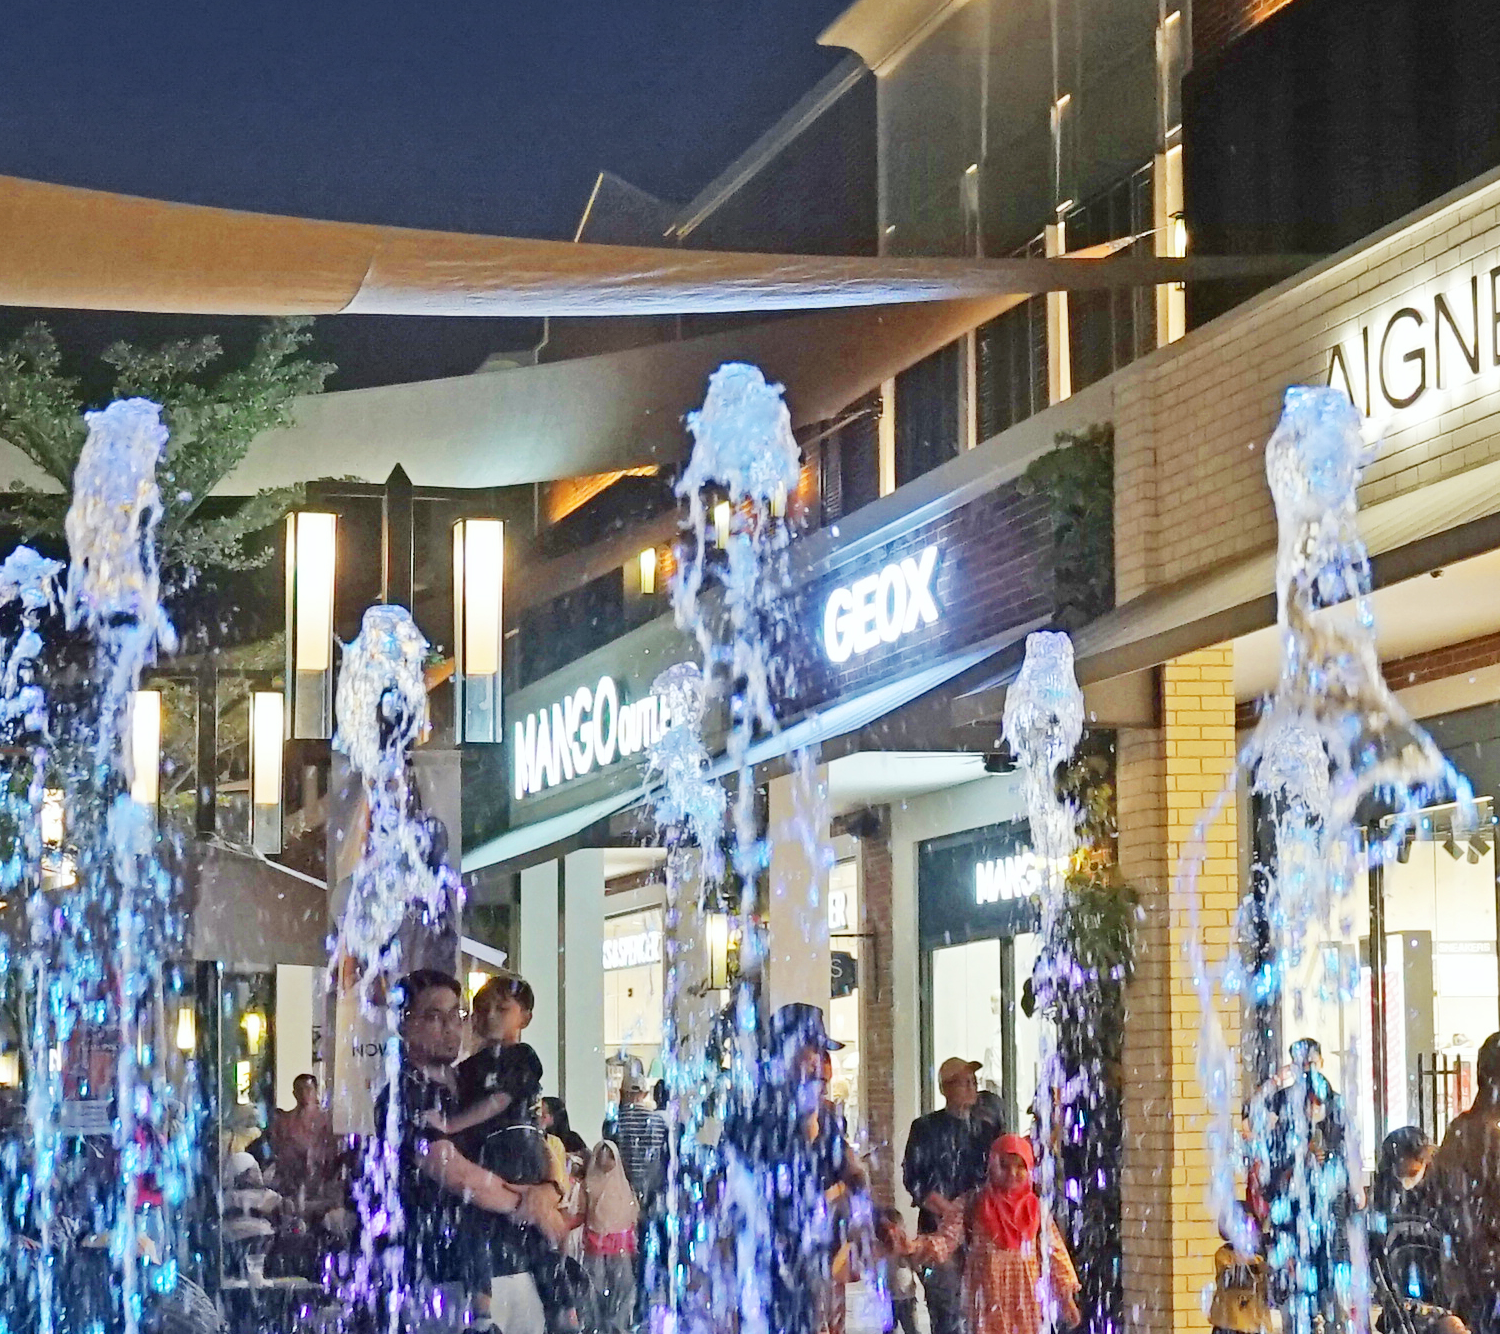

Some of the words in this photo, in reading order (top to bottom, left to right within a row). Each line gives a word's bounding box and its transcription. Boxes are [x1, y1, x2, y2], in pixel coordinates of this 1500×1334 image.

[823, 544, 940, 663] GEOX
[514, 674, 619, 801] MANGO
[617, 693, 674, 757] OUTLE
[975, 852, 1043, 905] MANG
[1438, 942, 1491, 953] SNEAKERS
